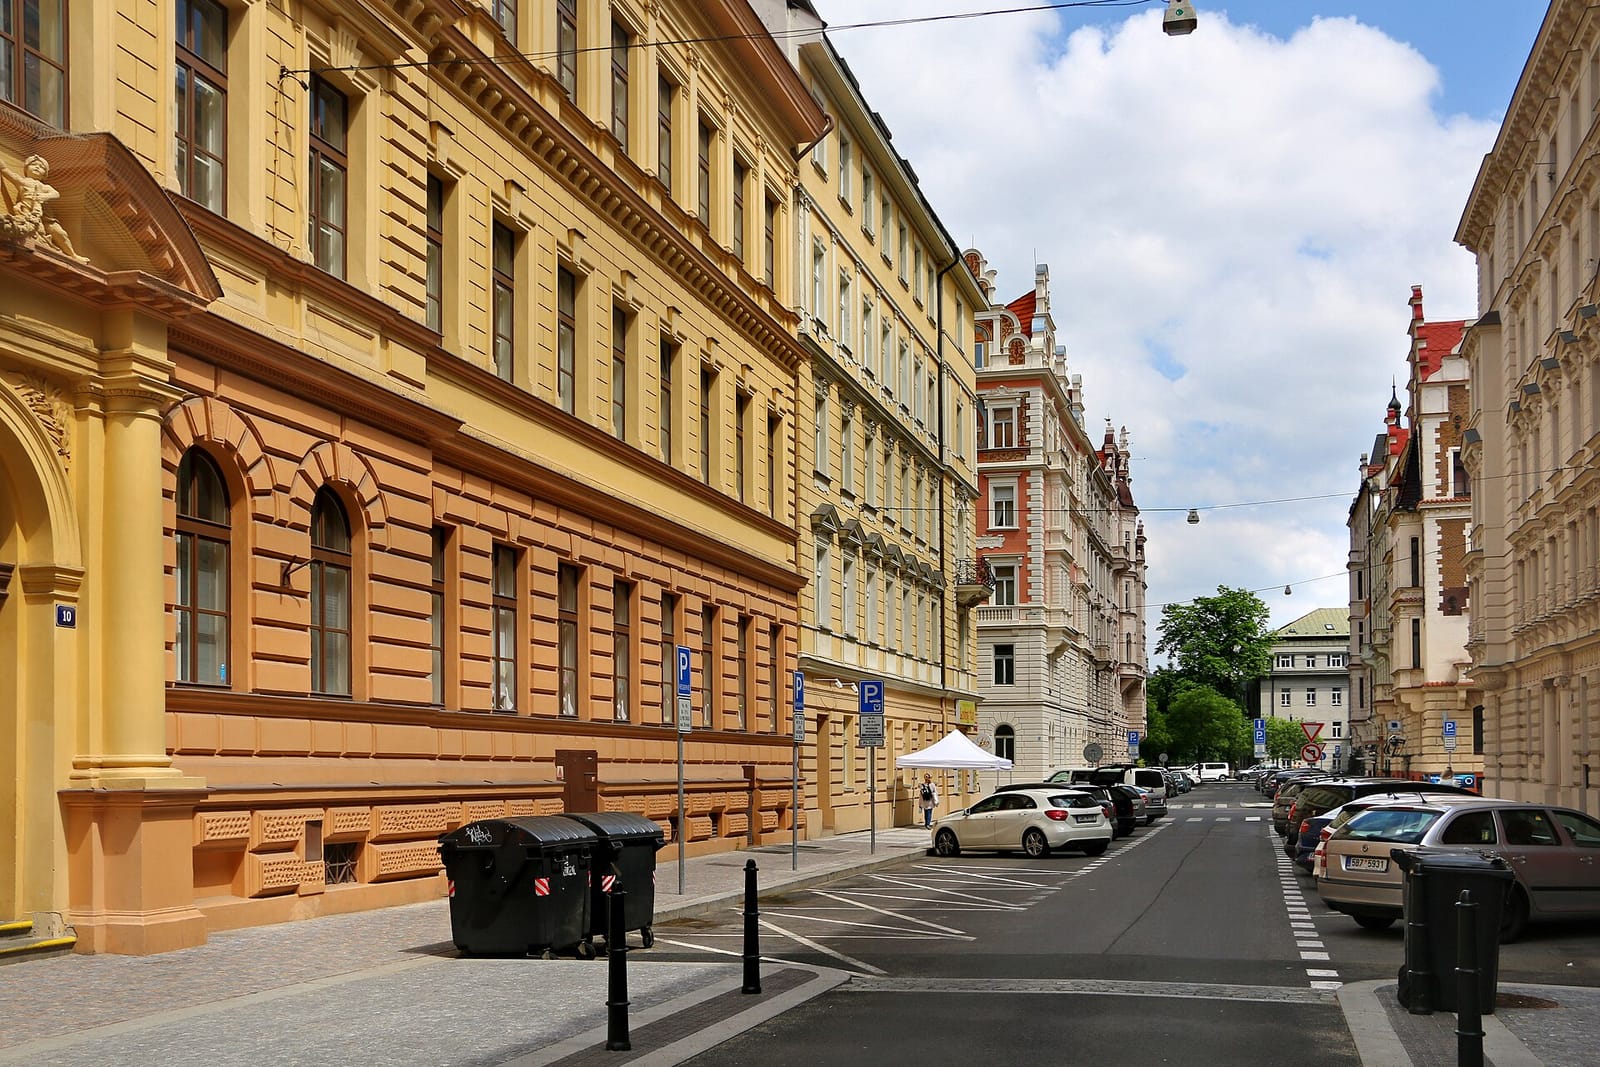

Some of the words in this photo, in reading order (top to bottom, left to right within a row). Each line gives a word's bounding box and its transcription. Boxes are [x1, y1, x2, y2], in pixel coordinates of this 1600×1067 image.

[63, 610, 71, 622] 10
[680, 652, 688, 680] P
[796, 676, 802, 699] P
[864, 684, 879, 704] P
[1446, 723, 1454, 732] P
[1130, 732, 1137, 741] P
[1256, 731, 1263, 740] P
